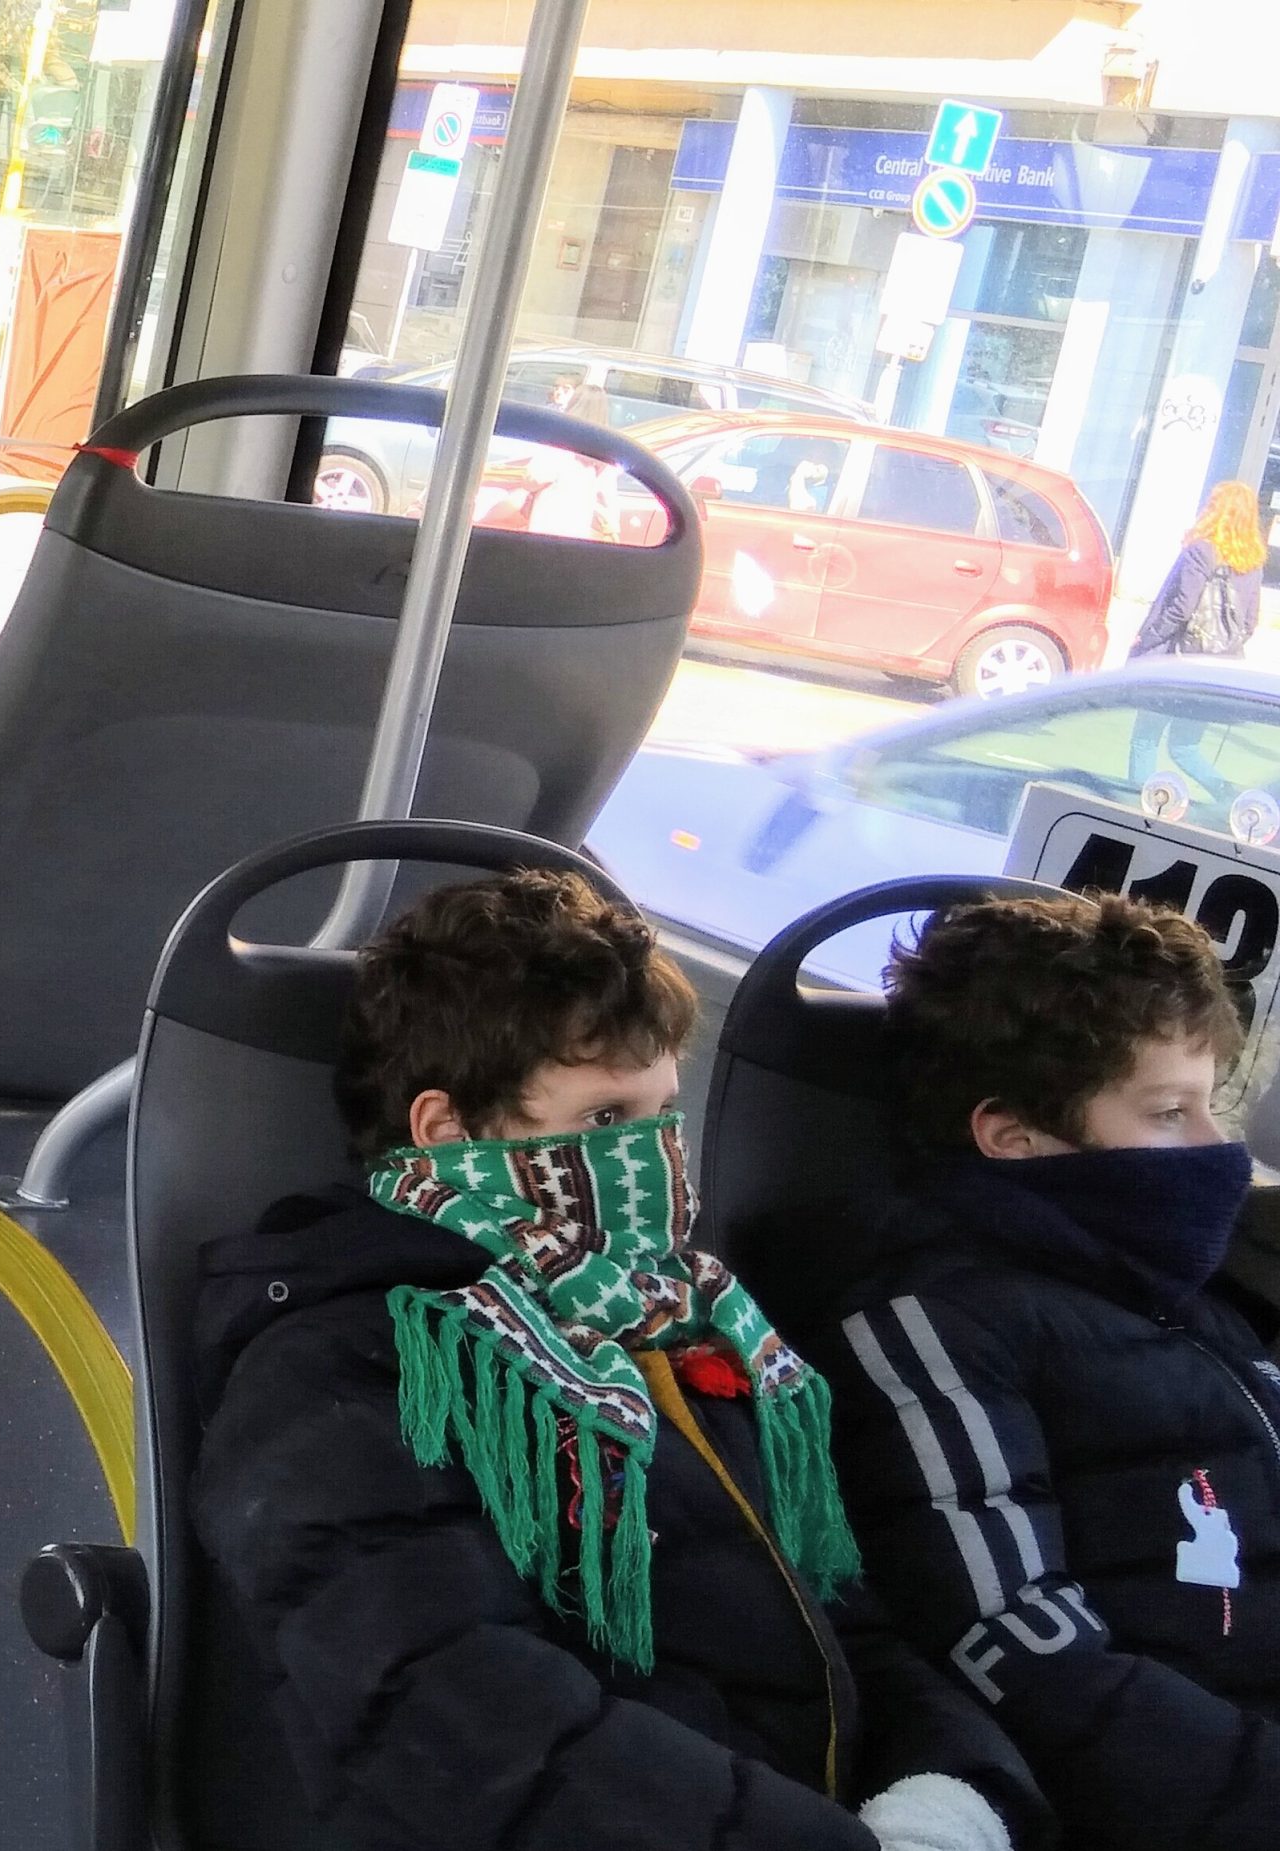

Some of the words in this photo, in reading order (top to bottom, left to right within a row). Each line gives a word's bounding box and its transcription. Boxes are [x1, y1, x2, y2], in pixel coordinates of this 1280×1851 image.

[876, 155, 923, 176] Central
[1018, 165, 1055, 187] Bank
[869, 190, 885, 199] CCB
[887, 191, 910, 203] Group
